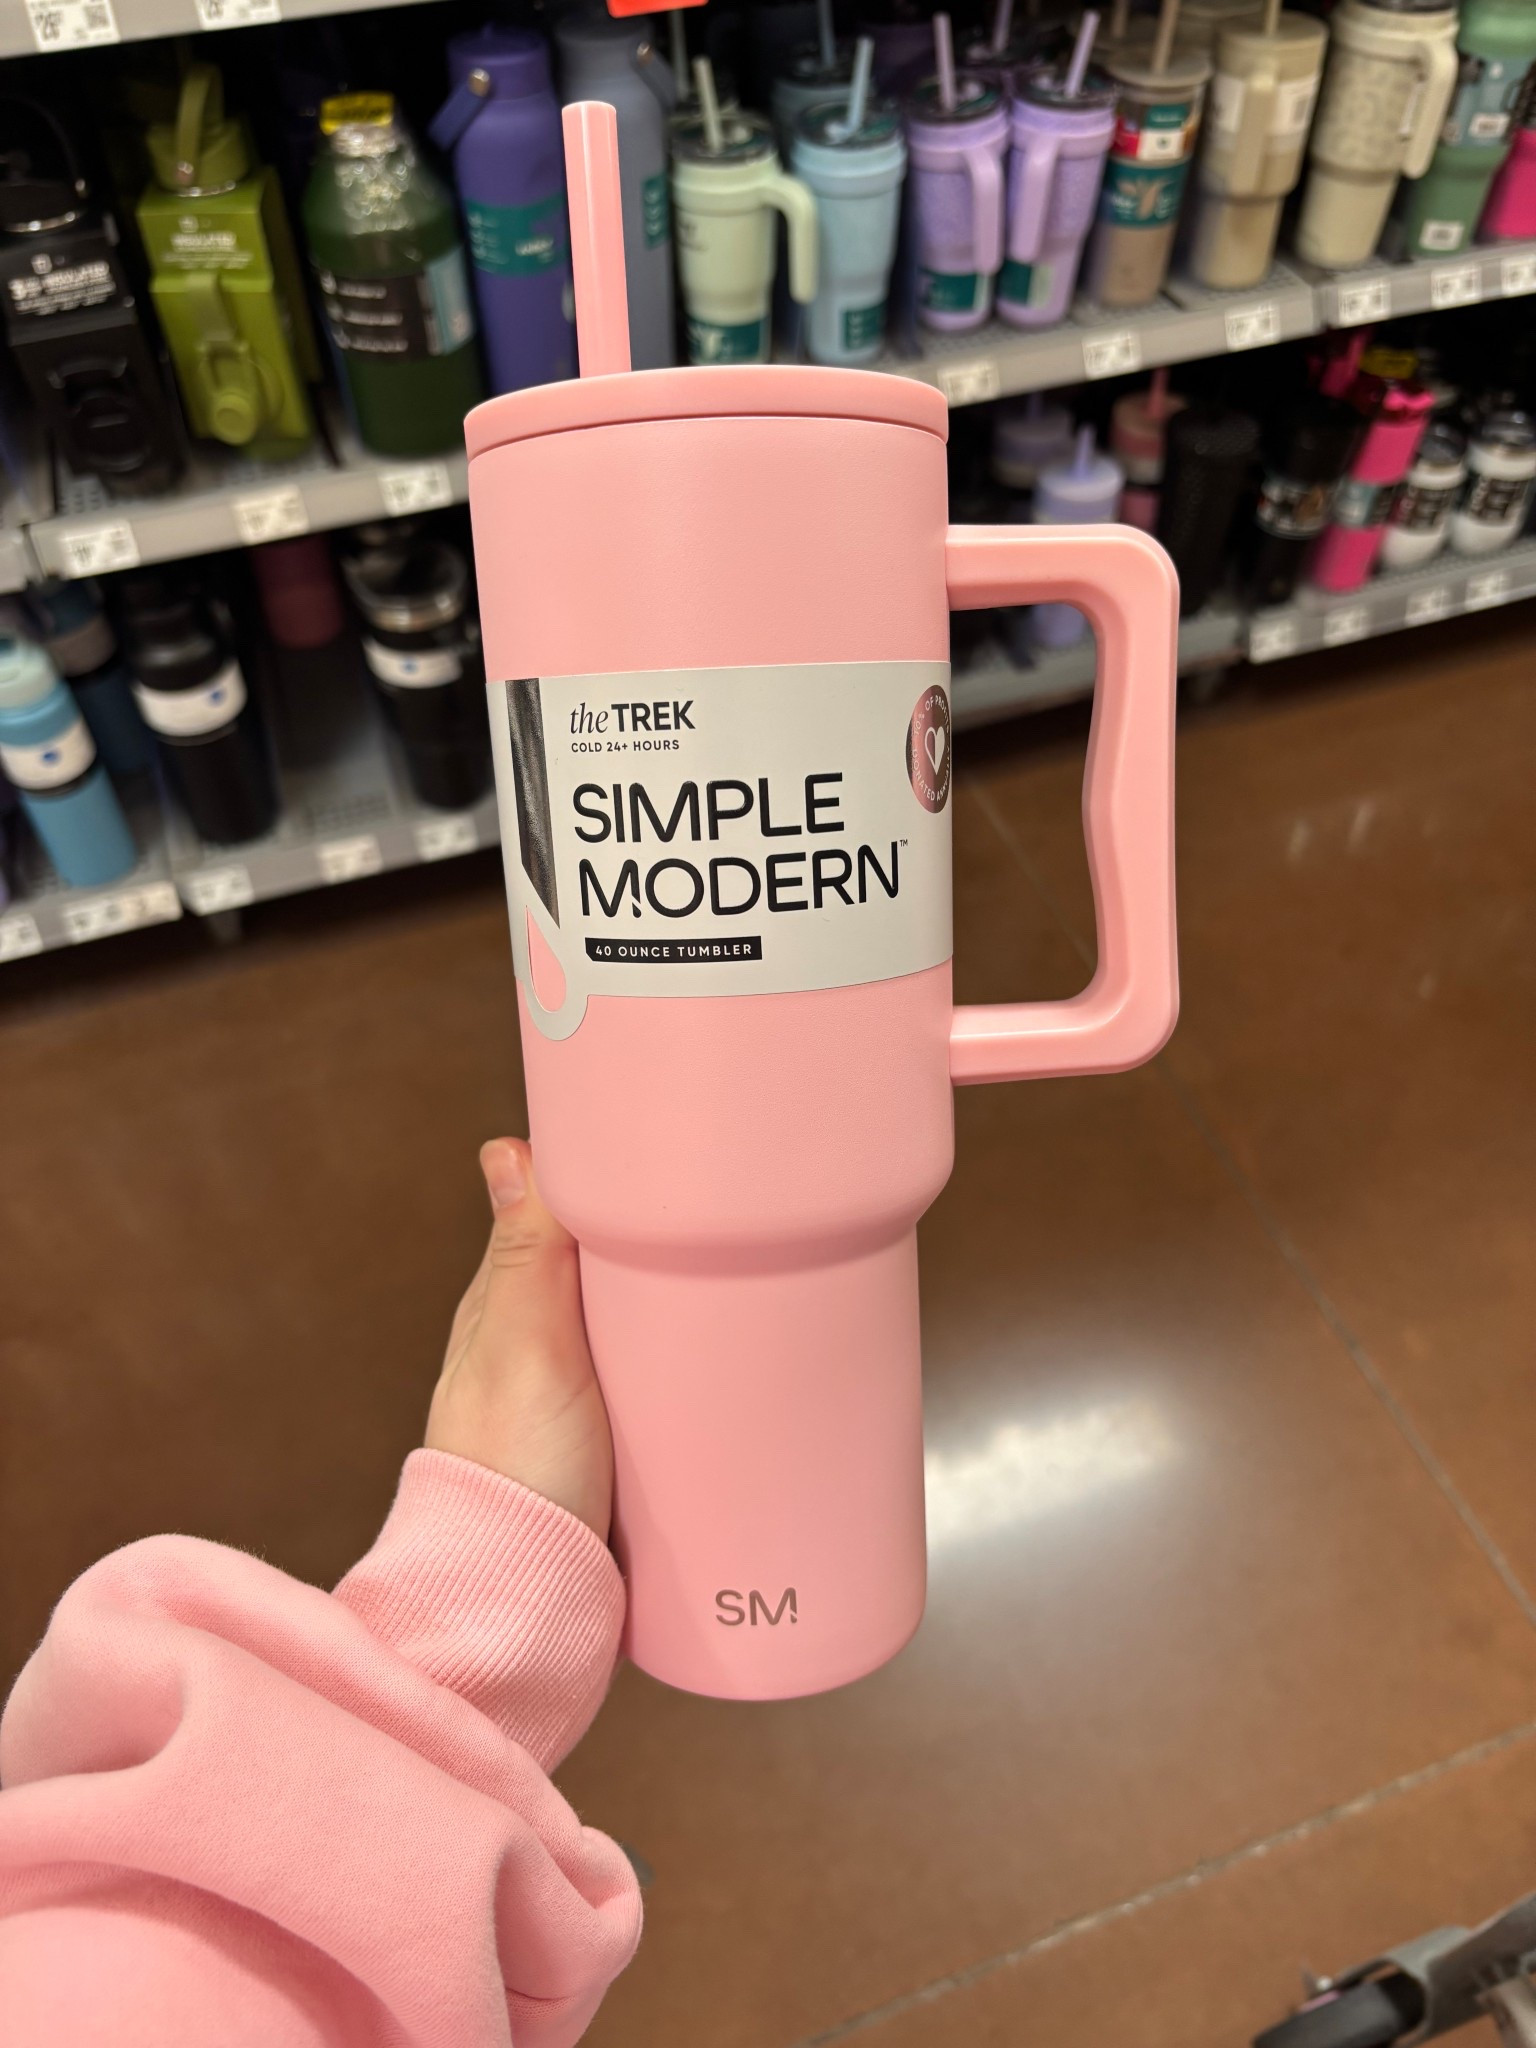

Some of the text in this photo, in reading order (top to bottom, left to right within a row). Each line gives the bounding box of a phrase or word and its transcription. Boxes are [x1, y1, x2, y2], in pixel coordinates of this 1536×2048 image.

[611, 699, 696, 732] TREK
[925, 696, 934, 711] OF
[571, 739, 680, 753] COLD 24+ HOURS
[573, 772, 845, 843] SIMPLE
[596, 943, 753, 957] 40 OUNCE TUMBLER
[715, 1587, 798, 1626] SM
